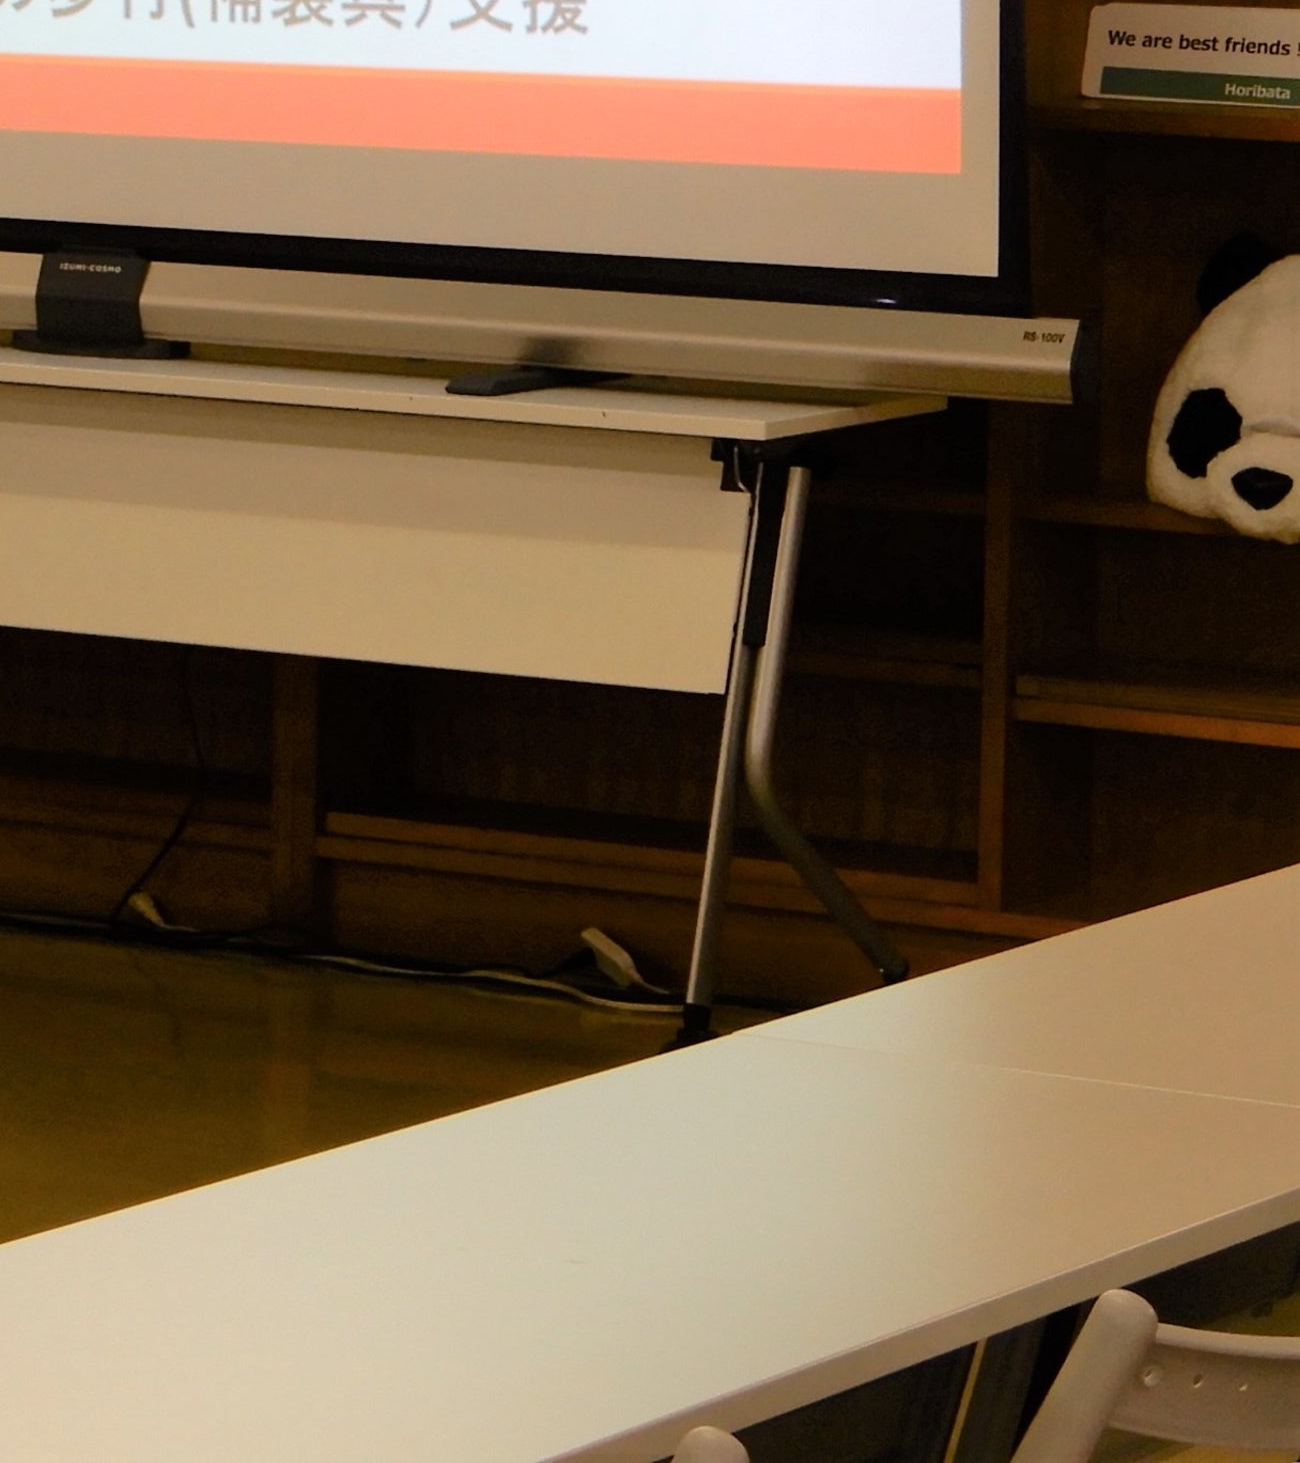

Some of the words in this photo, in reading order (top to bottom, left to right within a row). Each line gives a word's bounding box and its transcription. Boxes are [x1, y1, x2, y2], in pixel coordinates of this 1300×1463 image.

[1107, 29, 1136, 47] We
[1141, 35, 1173, 50] are
[1178, 34, 1219, 52] best
[1224, 37, 1291, 56] friends
[1224, 83, 1291, 100] Horibata
